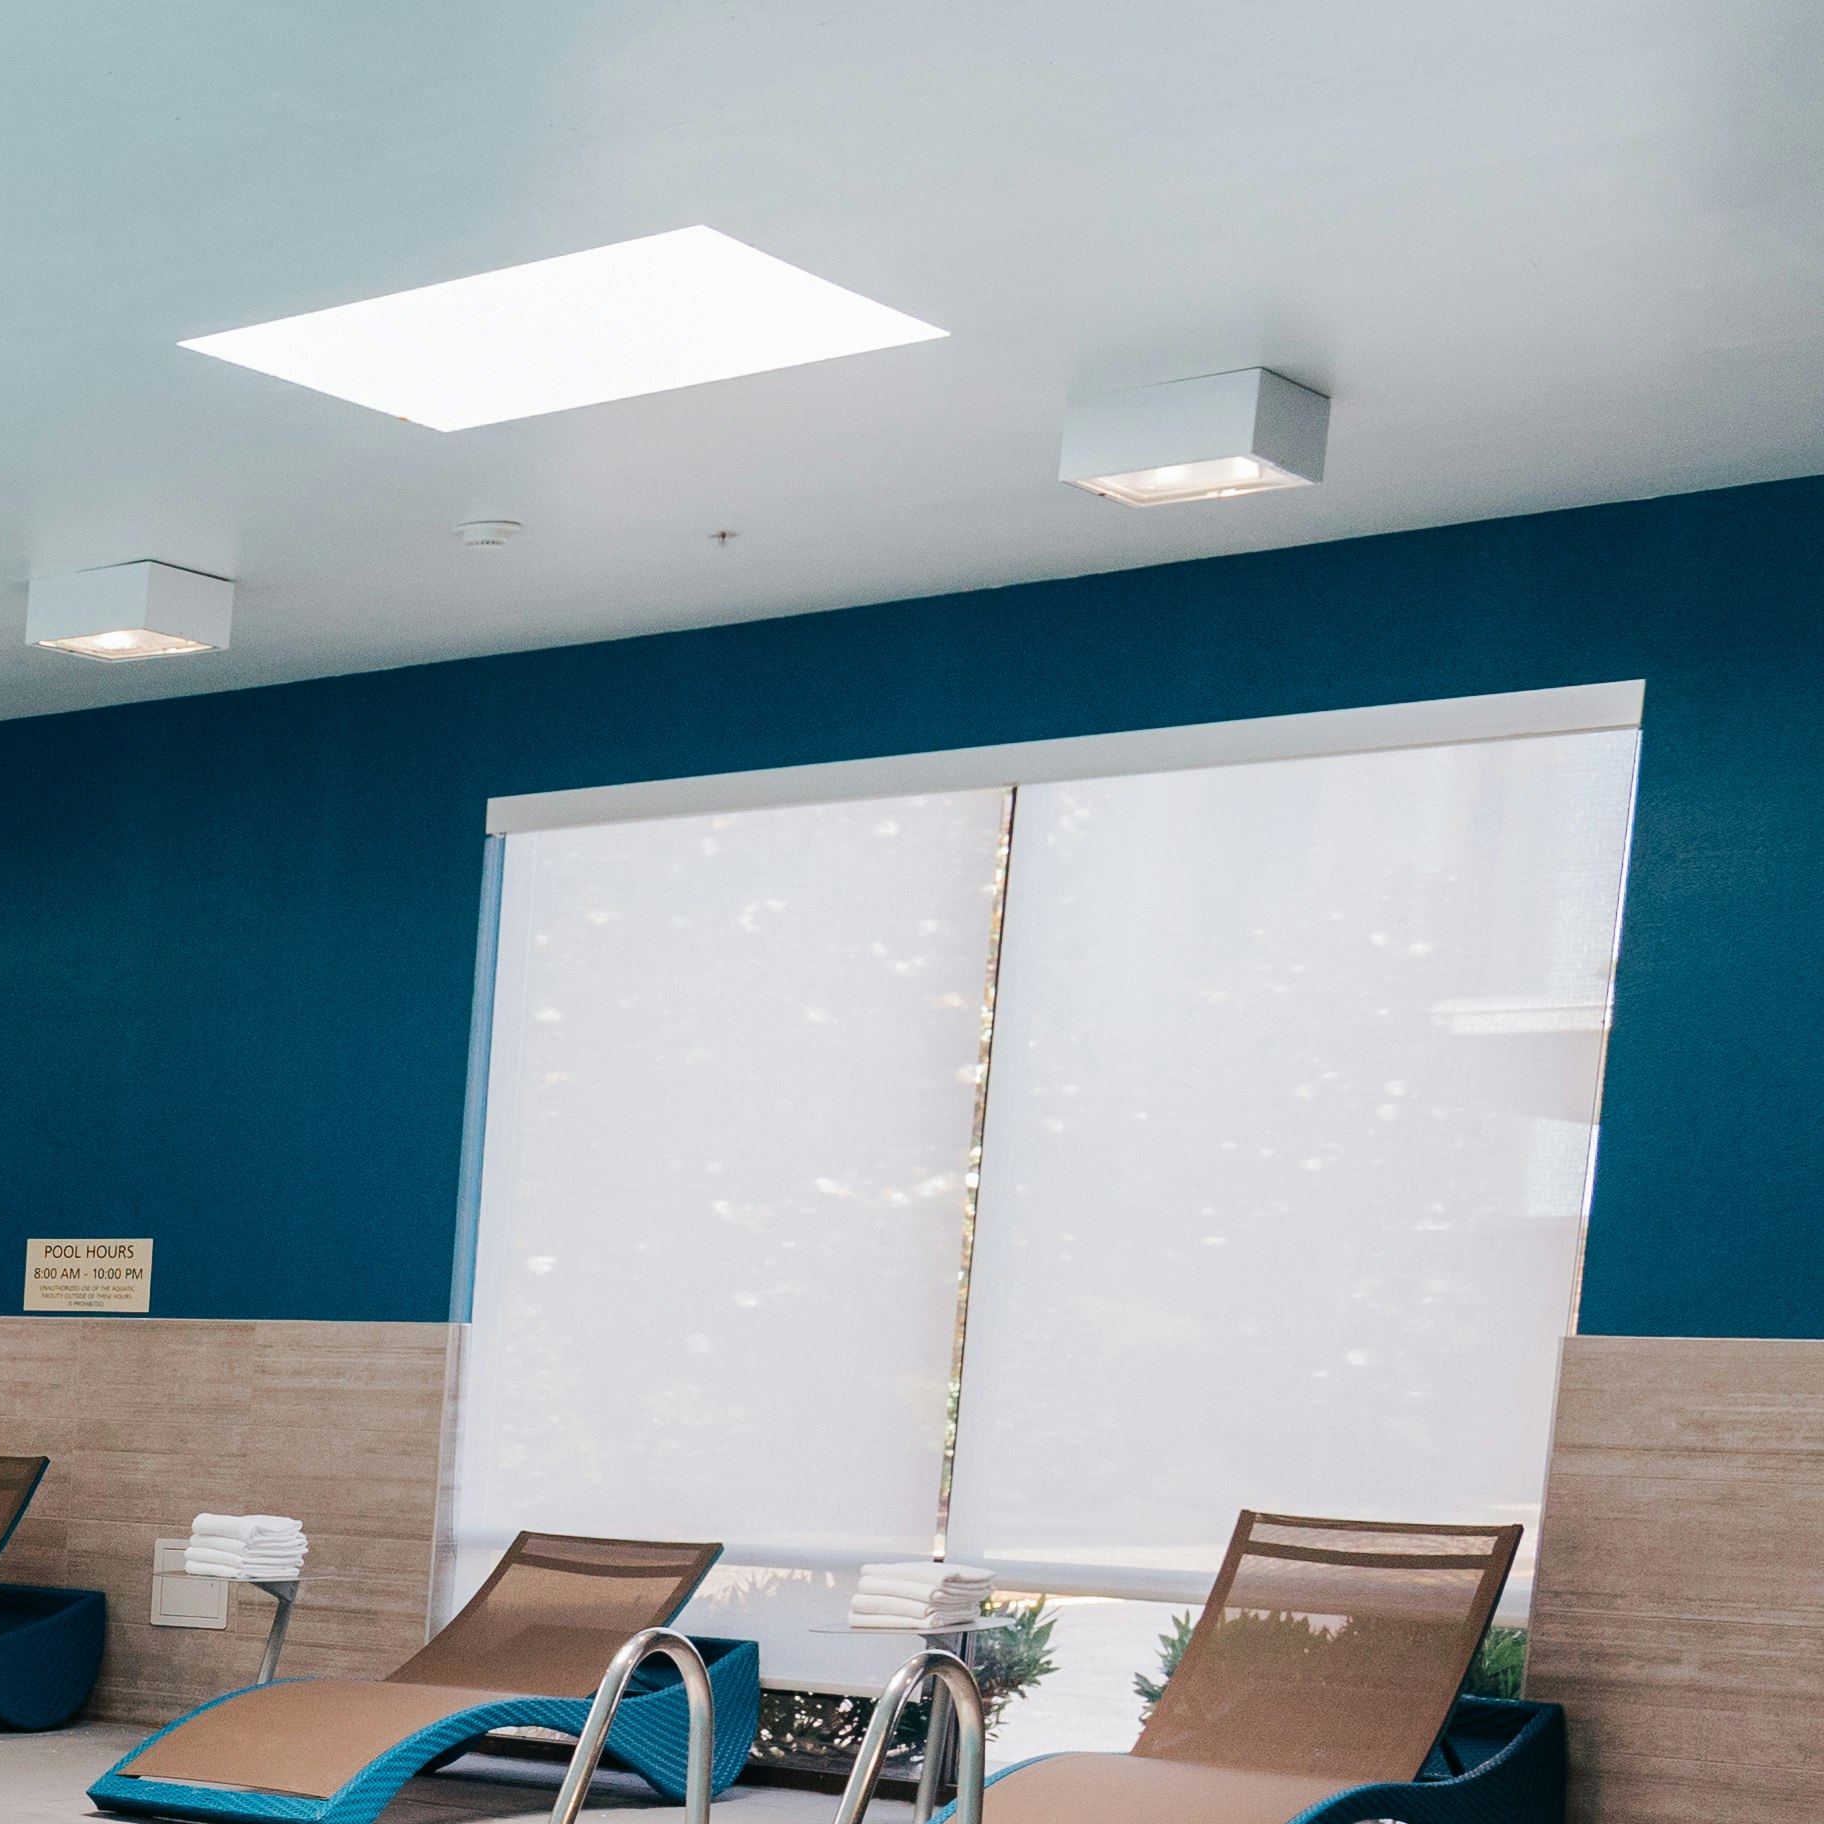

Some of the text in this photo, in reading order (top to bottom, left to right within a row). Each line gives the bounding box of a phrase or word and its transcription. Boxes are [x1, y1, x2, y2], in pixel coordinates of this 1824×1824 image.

[44, 1244, 134, 1259] POOL HOURS
[33, 1267, 57, 1280] 8:00
[59, 1268, 81, 1280] AM
[92, 1268, 123, 1281] 10:00
[126, 1268, 143, 1281] PM
